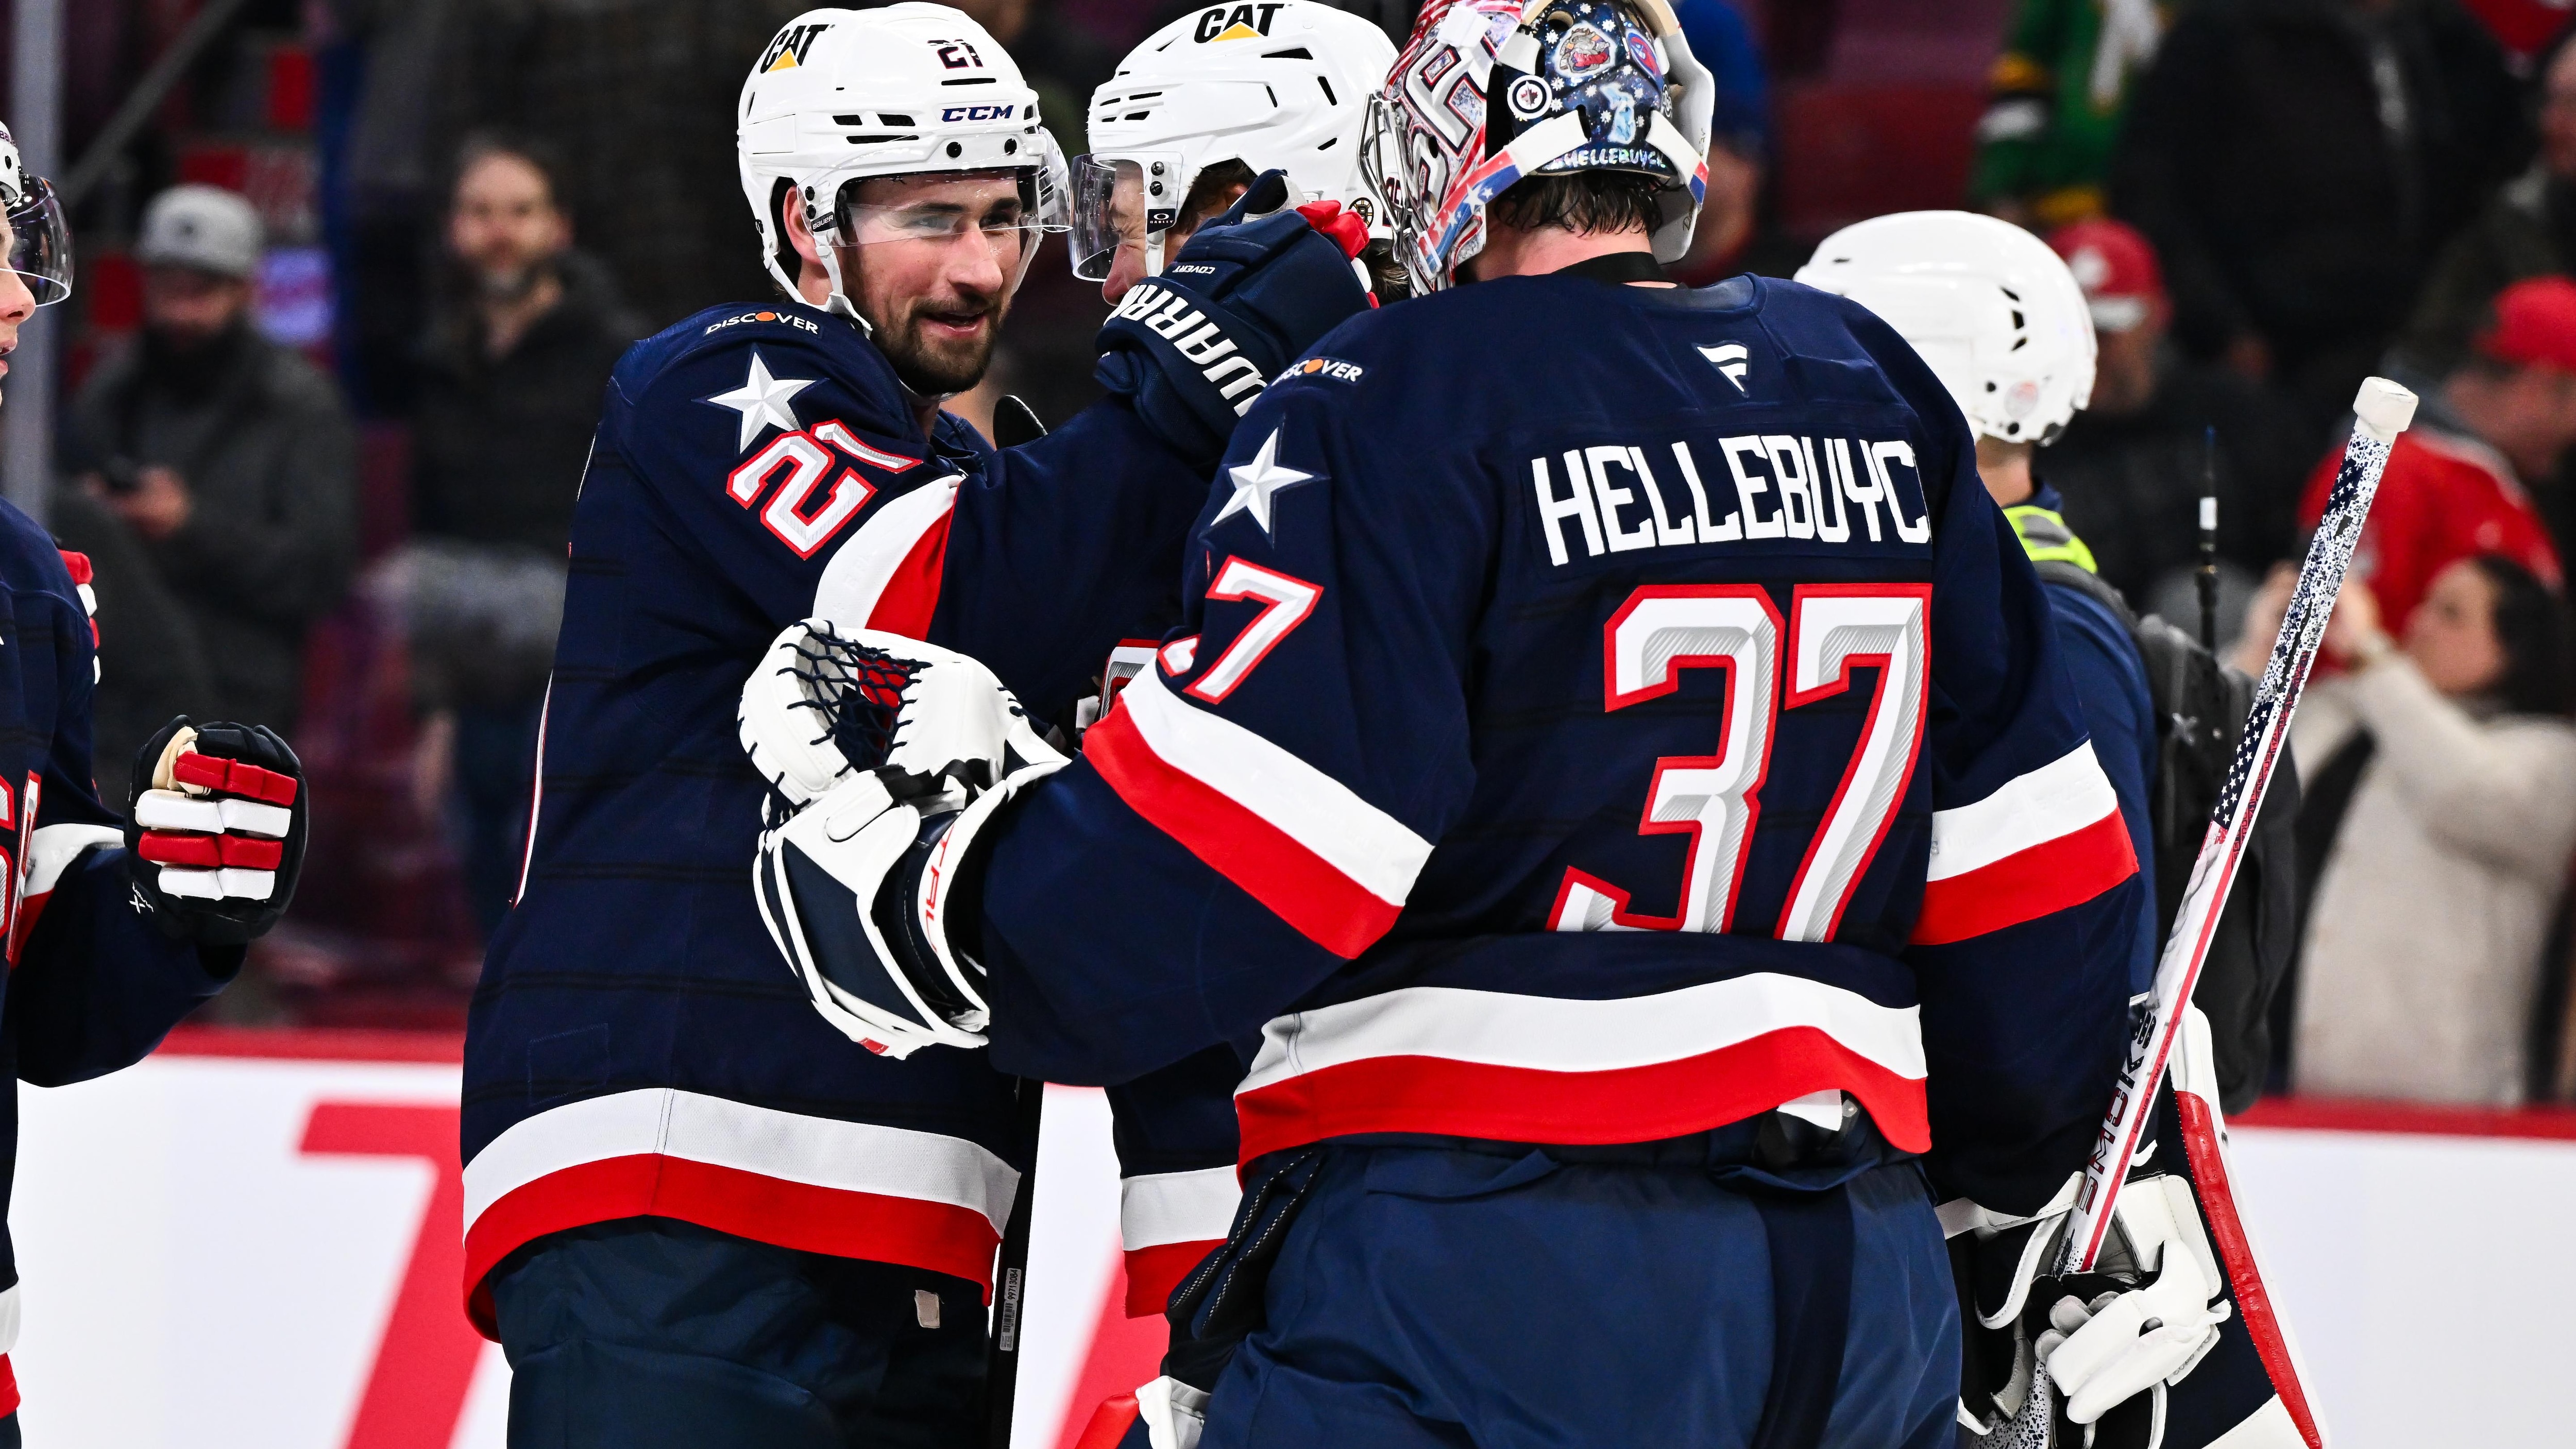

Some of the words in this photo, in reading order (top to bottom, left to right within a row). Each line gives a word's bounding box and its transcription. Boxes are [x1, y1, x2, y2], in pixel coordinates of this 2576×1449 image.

[1194, 4, 1285, 44] CAT
[760, 24, 829, 74] CAT
[927, 39, 984, 69] 21
[941, 105, 1014, 123] CCM
[1172, 265, 1216, 274] COVERT
[705, 312, 818, 335] DISCOVER
[725, 418, 923, 561] 21
[1532, 435, 1932, 566] HELLEBUYC
[1546, 583, 1933, 943] 37
